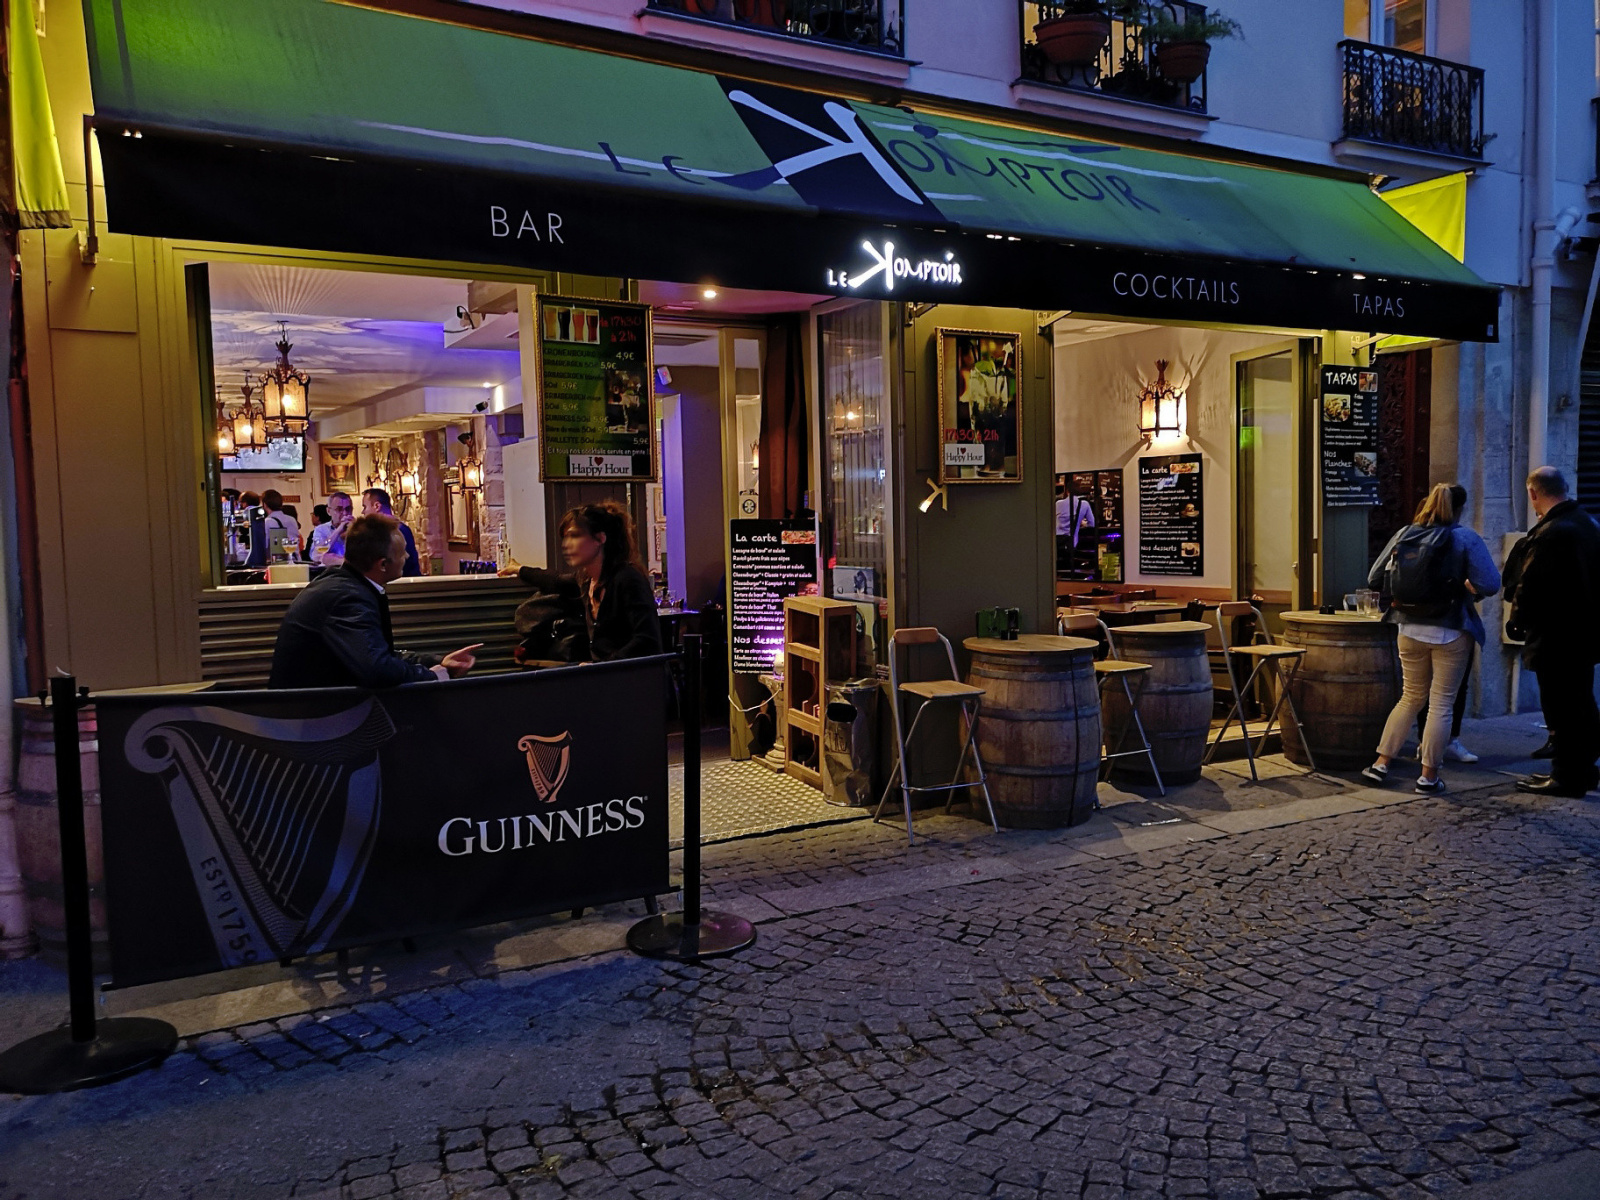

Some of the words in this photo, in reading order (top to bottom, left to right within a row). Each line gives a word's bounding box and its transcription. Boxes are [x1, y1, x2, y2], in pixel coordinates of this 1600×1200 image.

[490, 205, 565, 244] BAR
[827, 268, 847, 288] LE
[1113, 271, 1241, 305] COCKTAILS
[1353, 293, 1405, 319] TAPAS
[616, 351, 635, 361] 4,9€
[600, 361, 617, 370] 5,9€
[1325, 372, 1358, 386] TAPAS
[633, 437, 650, 447] 5,9€
[946, 452, 966, 463] Happy
[967, 453, 983, 461] Hour
[1324, 450, 1336, 458] Nos
[588, 456, 593, 467] I
[572, 464, 603, 476] Happy
[605, 464, 630, 475] Hour
[1142, 467, 1150, 475] La
[1152, 466, 1168, 474] carte
[735, 533, 748, 542] La
[751, 533, 778, 543] carte
[1153, 544, 1177, 552] desserts
[733, 636, 751, 644] Nos
[437, 795, 646, 857] GUINNESS
